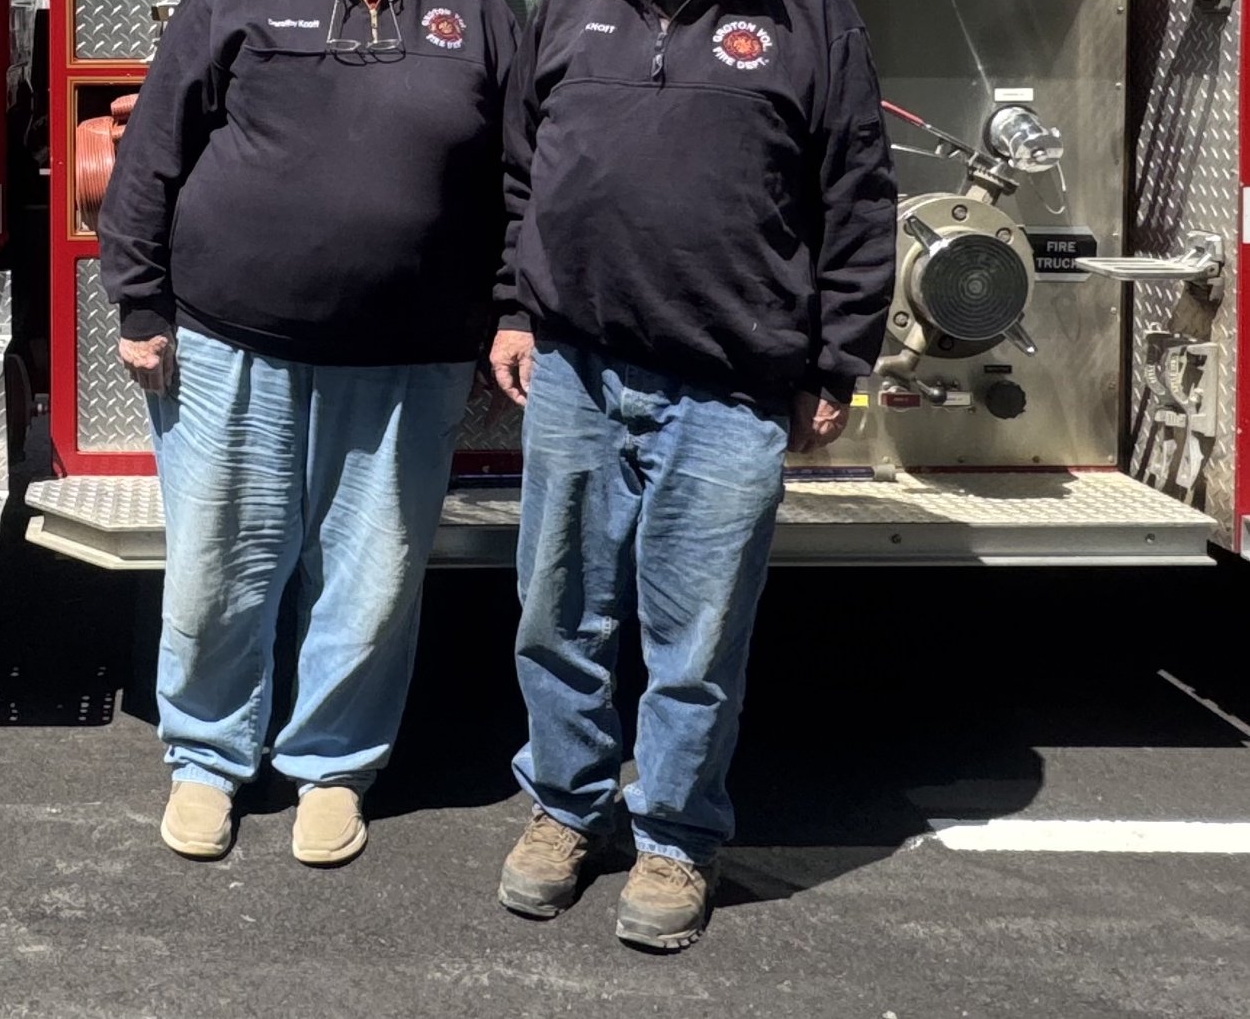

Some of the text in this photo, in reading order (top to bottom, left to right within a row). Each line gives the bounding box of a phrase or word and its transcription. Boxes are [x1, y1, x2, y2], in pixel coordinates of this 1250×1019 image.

[712, 21, 756, 43] GROTON
[712, 46, 736, 66] FIRE
[1046, 241, 1077, 253] FIRE
